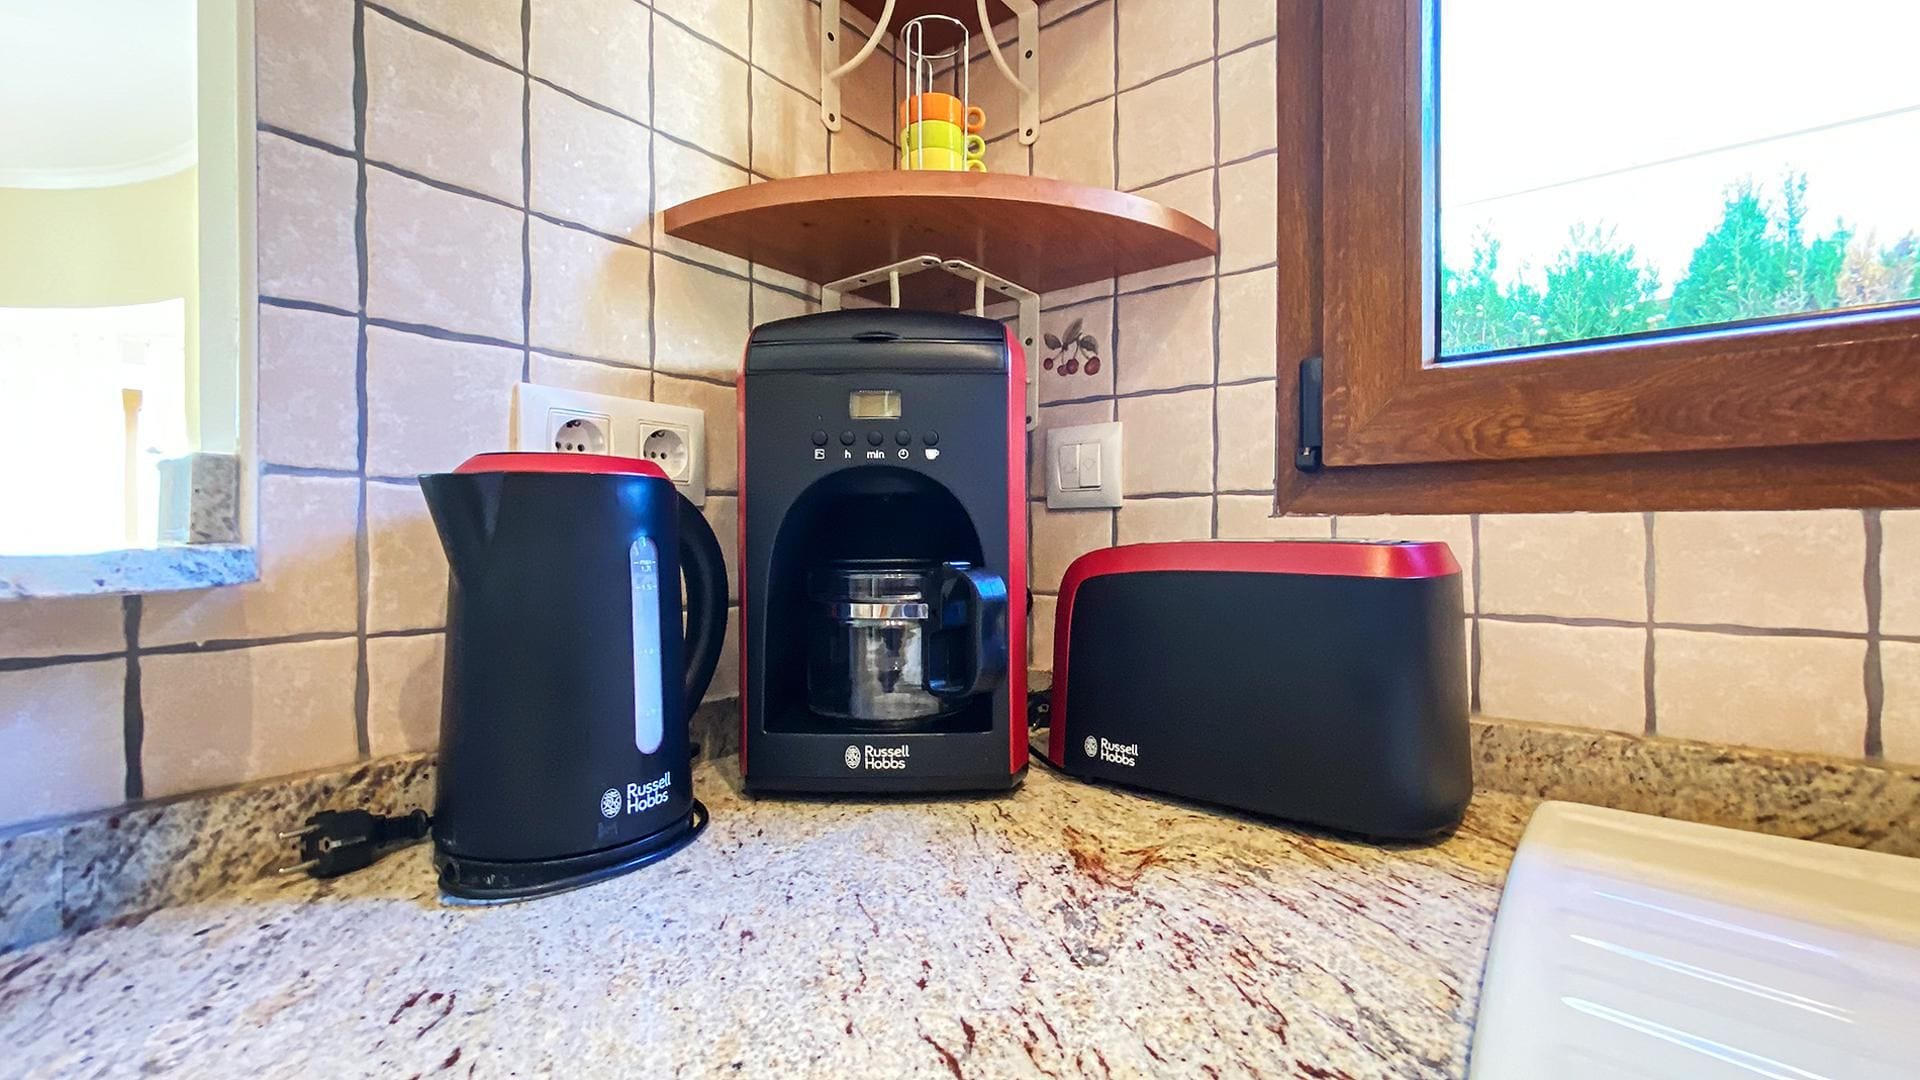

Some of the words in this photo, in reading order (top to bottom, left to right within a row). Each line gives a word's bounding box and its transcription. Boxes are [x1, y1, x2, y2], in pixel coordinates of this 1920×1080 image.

[844, 449, 852, 459] h
[866, 449, 885, 459] min
[864, 744, 910, 757] Russell
[1100, 737, 1138, 756] Russell
[864, 757, 906, 769] Hobbs
[1100, 749, 1136, 767] Hobbs
[627, 771, 671, 799] Russell
[627, 790, 669, 814] Hobbs
